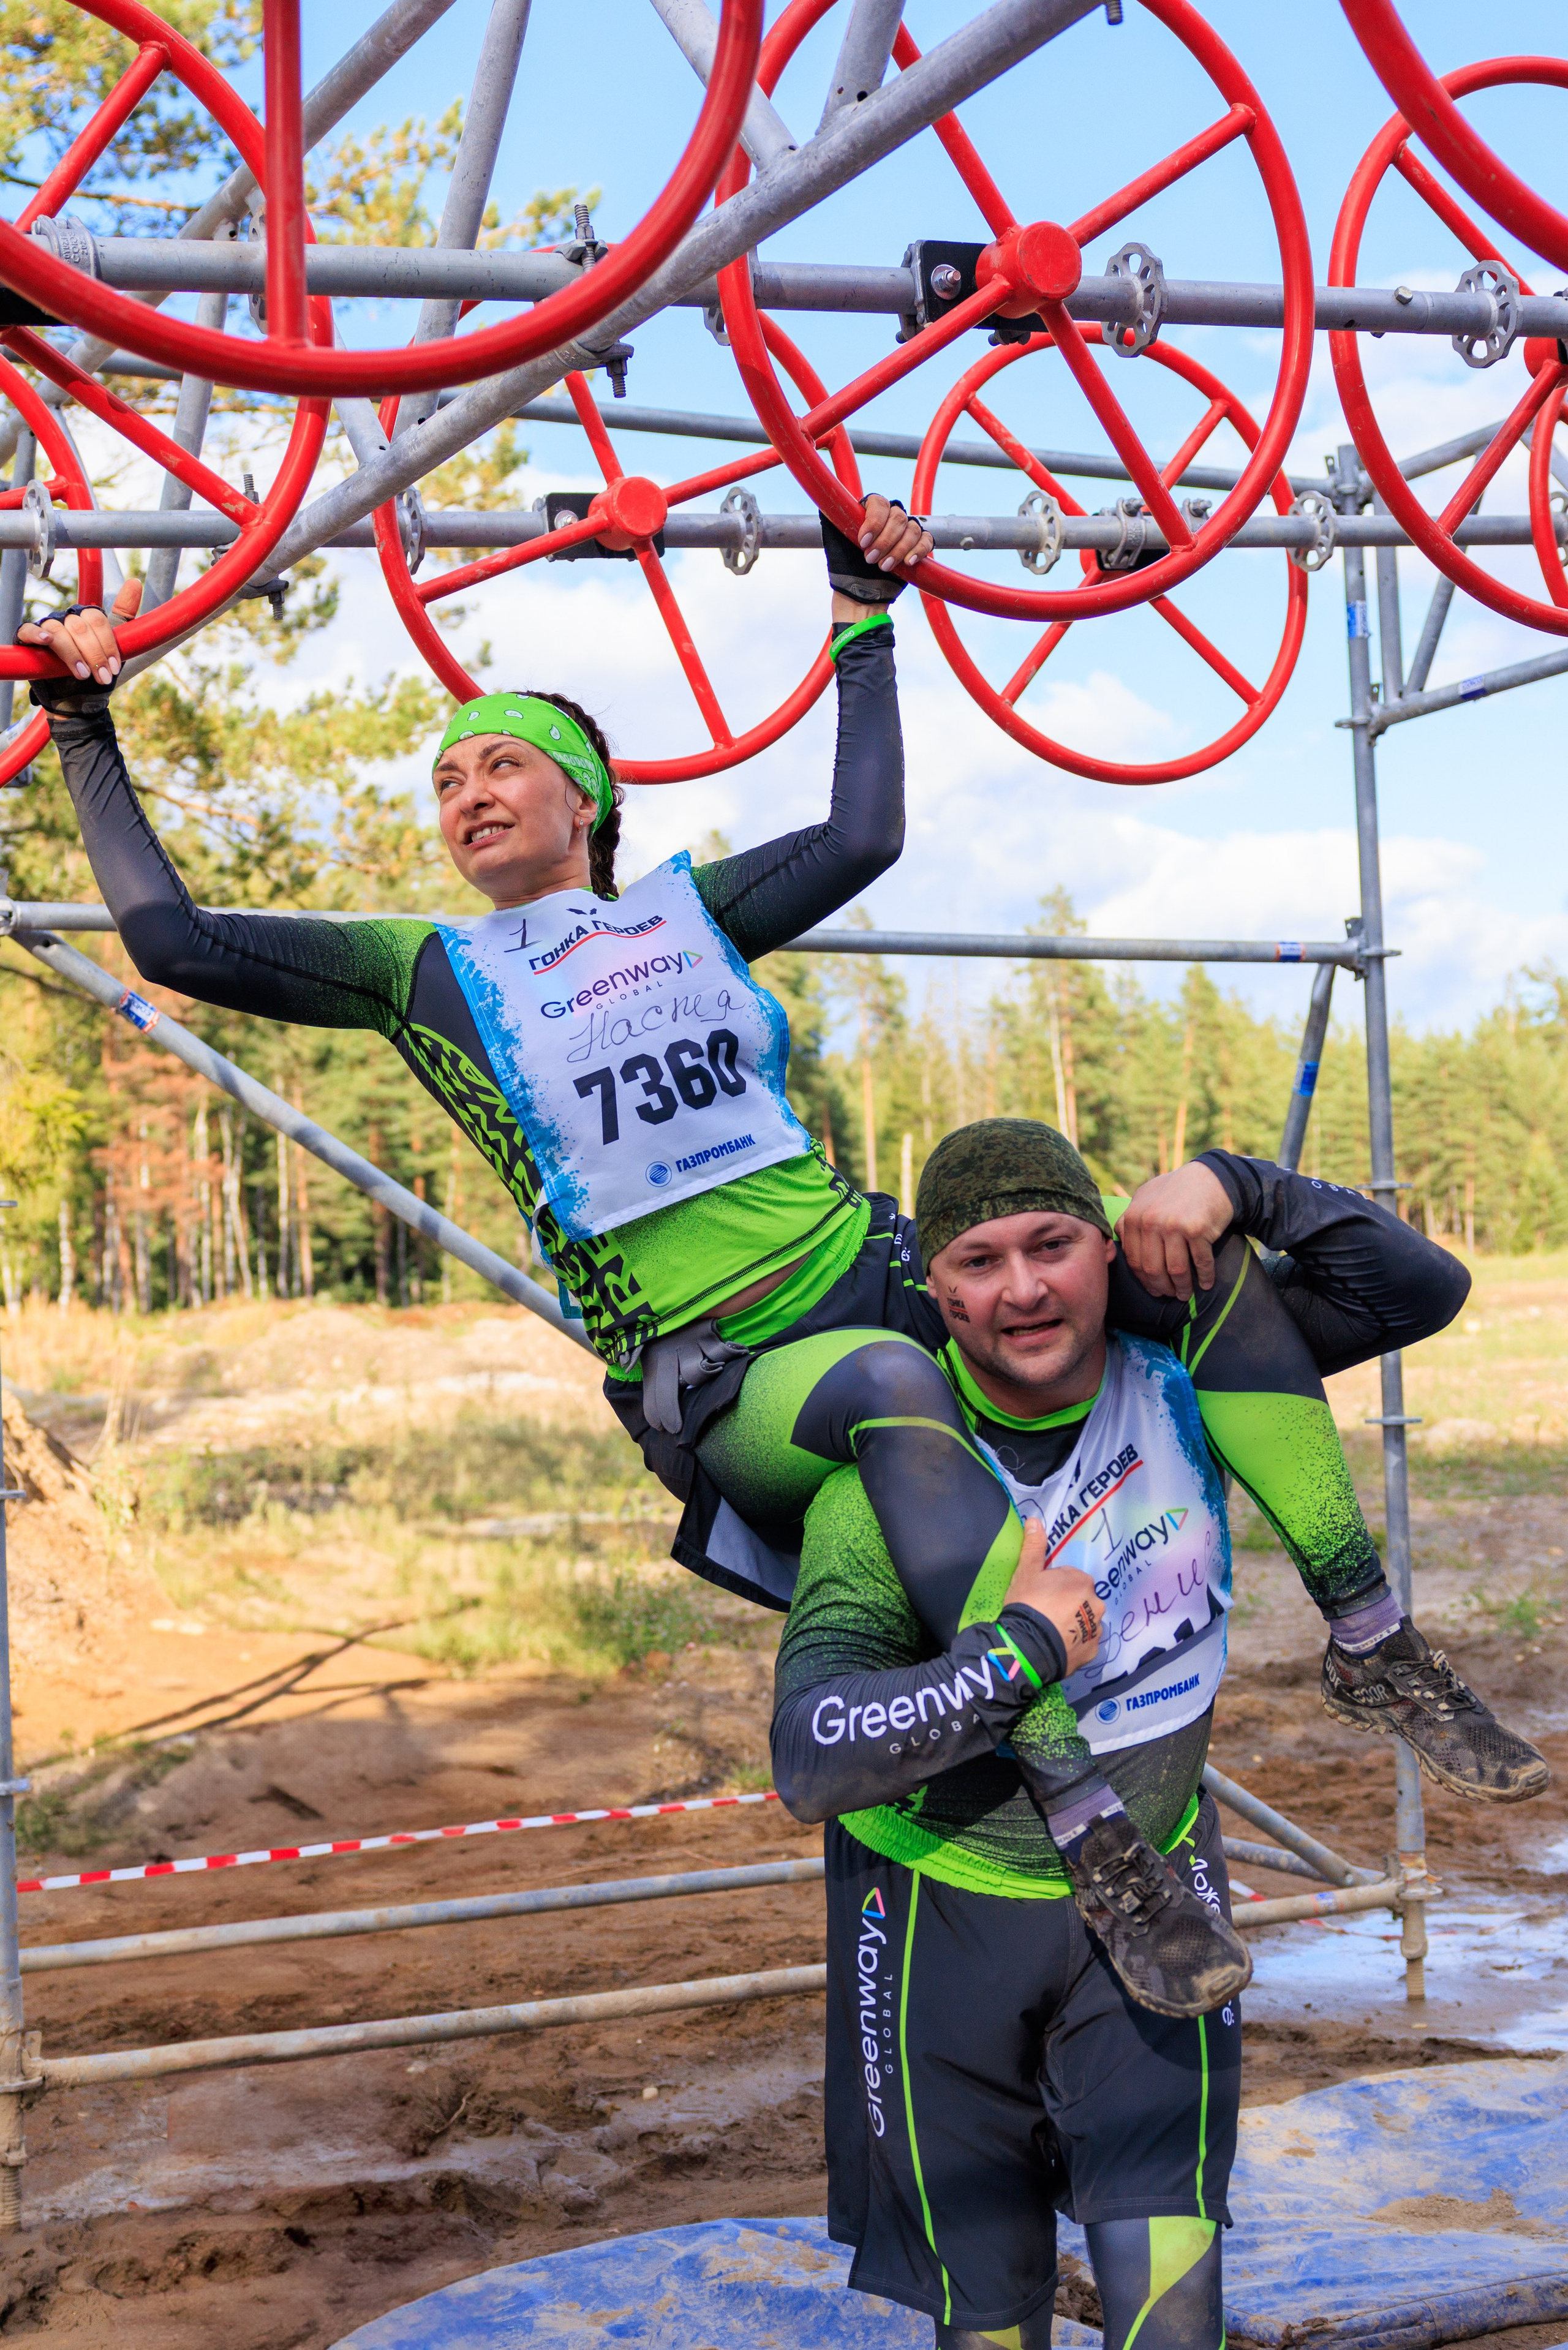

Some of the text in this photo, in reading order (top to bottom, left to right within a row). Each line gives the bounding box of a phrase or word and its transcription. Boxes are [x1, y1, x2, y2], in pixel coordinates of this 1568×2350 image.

[529, 915, 663, 970] ГОНКА ГЕРОЕВ
[541, 951, 683, 1019] Greenway
[596, 981, 663, 1010] GLOBAL
[573, 1028, 747, 1145] 7360
[676, 1134, 756, 1173] ГАЗПРОМБАНК
[1045, 1443, 1138, 1556] НКА ГЕРОЕВ
[1095, 1515, 1169, 1600] eenway
[813, 1655, 994, 1745] Greenwy
[1126, 1673, 1200, 1711] ГАЗПРОМБАНК
[889, 1713, 980, 1754] GLOBA
[858, 1918, 886, 2137] Greenway
[883, 1973, 893, 2074] GLOBAL
